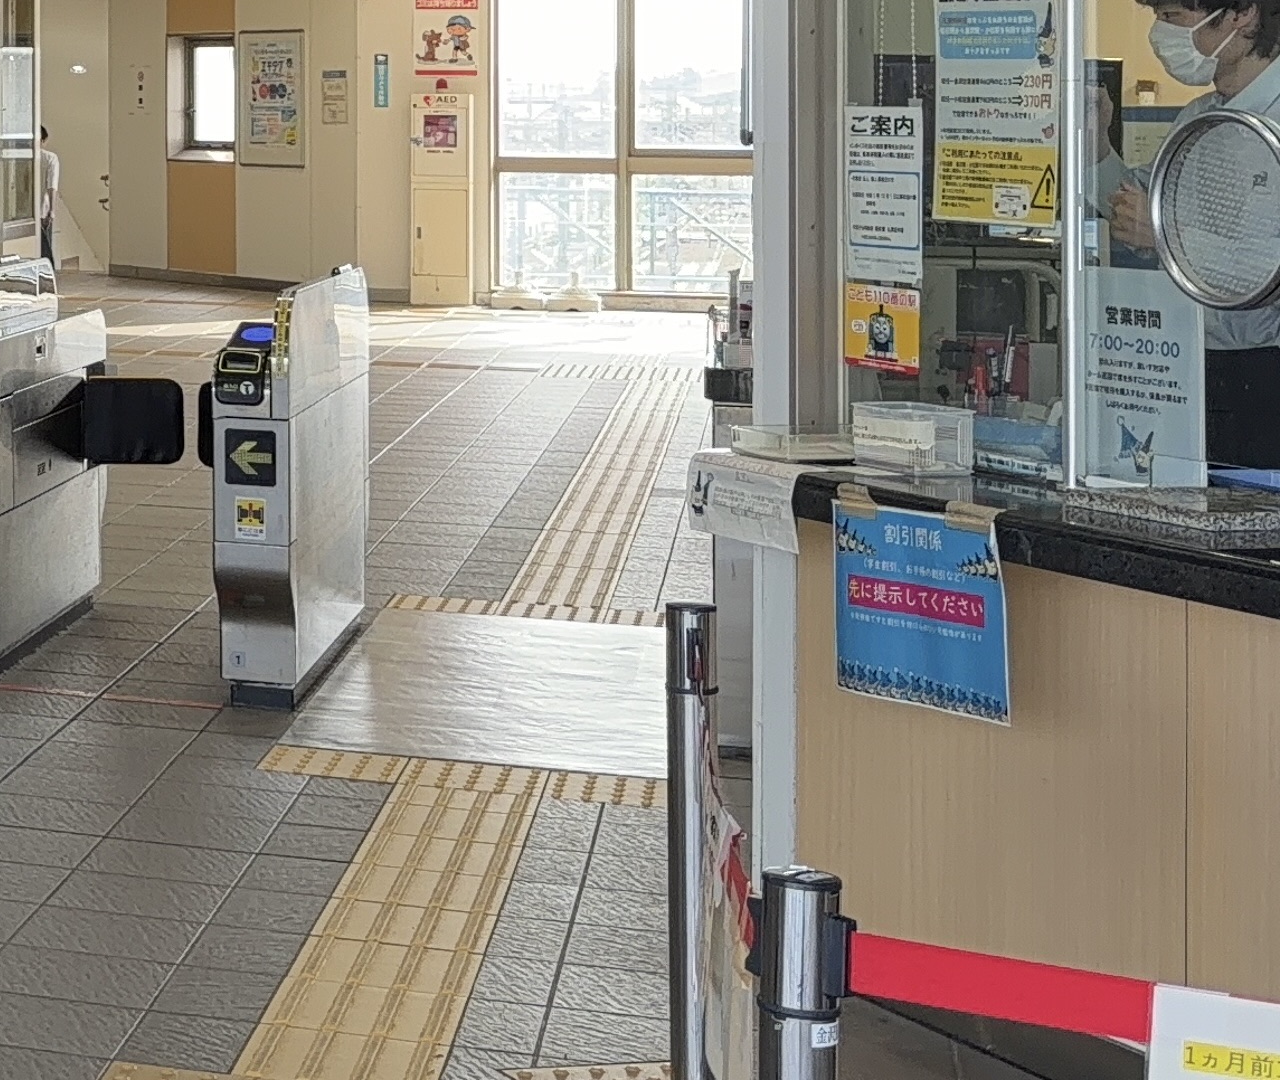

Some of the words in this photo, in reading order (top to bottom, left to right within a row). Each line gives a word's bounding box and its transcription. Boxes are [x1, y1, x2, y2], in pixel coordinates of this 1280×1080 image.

[1023, 73, 1053, 89] 230円
[436, 95, 457, 103] AED
[1023, 93, 1052, 109] 370円
[851, 114, 915, 136] ご案内
[847, 287, 917, 307] こども110番の駅
[1105, 305, 1161, 329] 営業時間
[884, 523, 943, 552] 割引関係
[848, 578, 984, 617] 先に提示してください
[236, 655, 241, 665] 1
